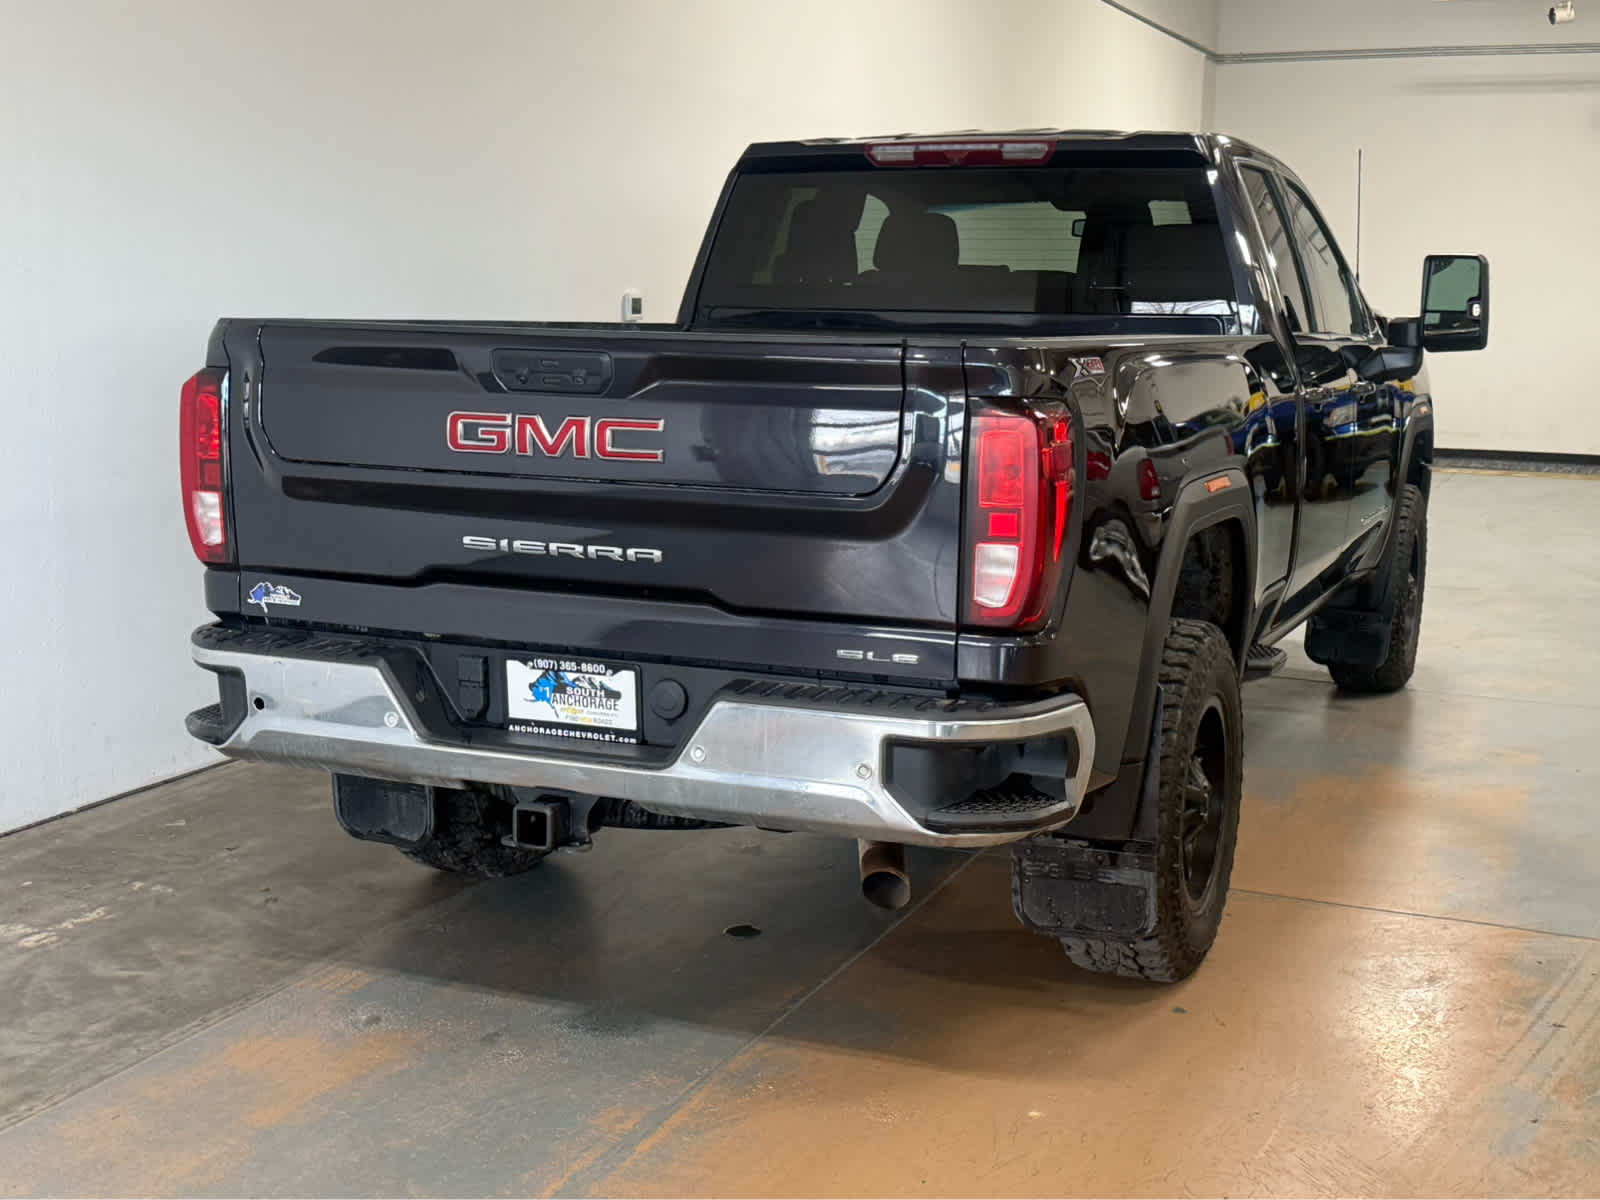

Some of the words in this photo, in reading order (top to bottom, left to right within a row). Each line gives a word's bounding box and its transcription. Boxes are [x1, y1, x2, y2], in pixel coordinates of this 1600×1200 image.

[447, 410, 665, 463] GMC
[462, 535, 663, 563] SIERRA
[533, 658, 558, 671] (907)
[836, 649, 919, 664] SLE
[566, 686, 605, 698] SOUTH
[551, 693, 620, 711] ANCHORAGE
[508, 724, 637, 744] ANCHORAGECHEVROLET.com
